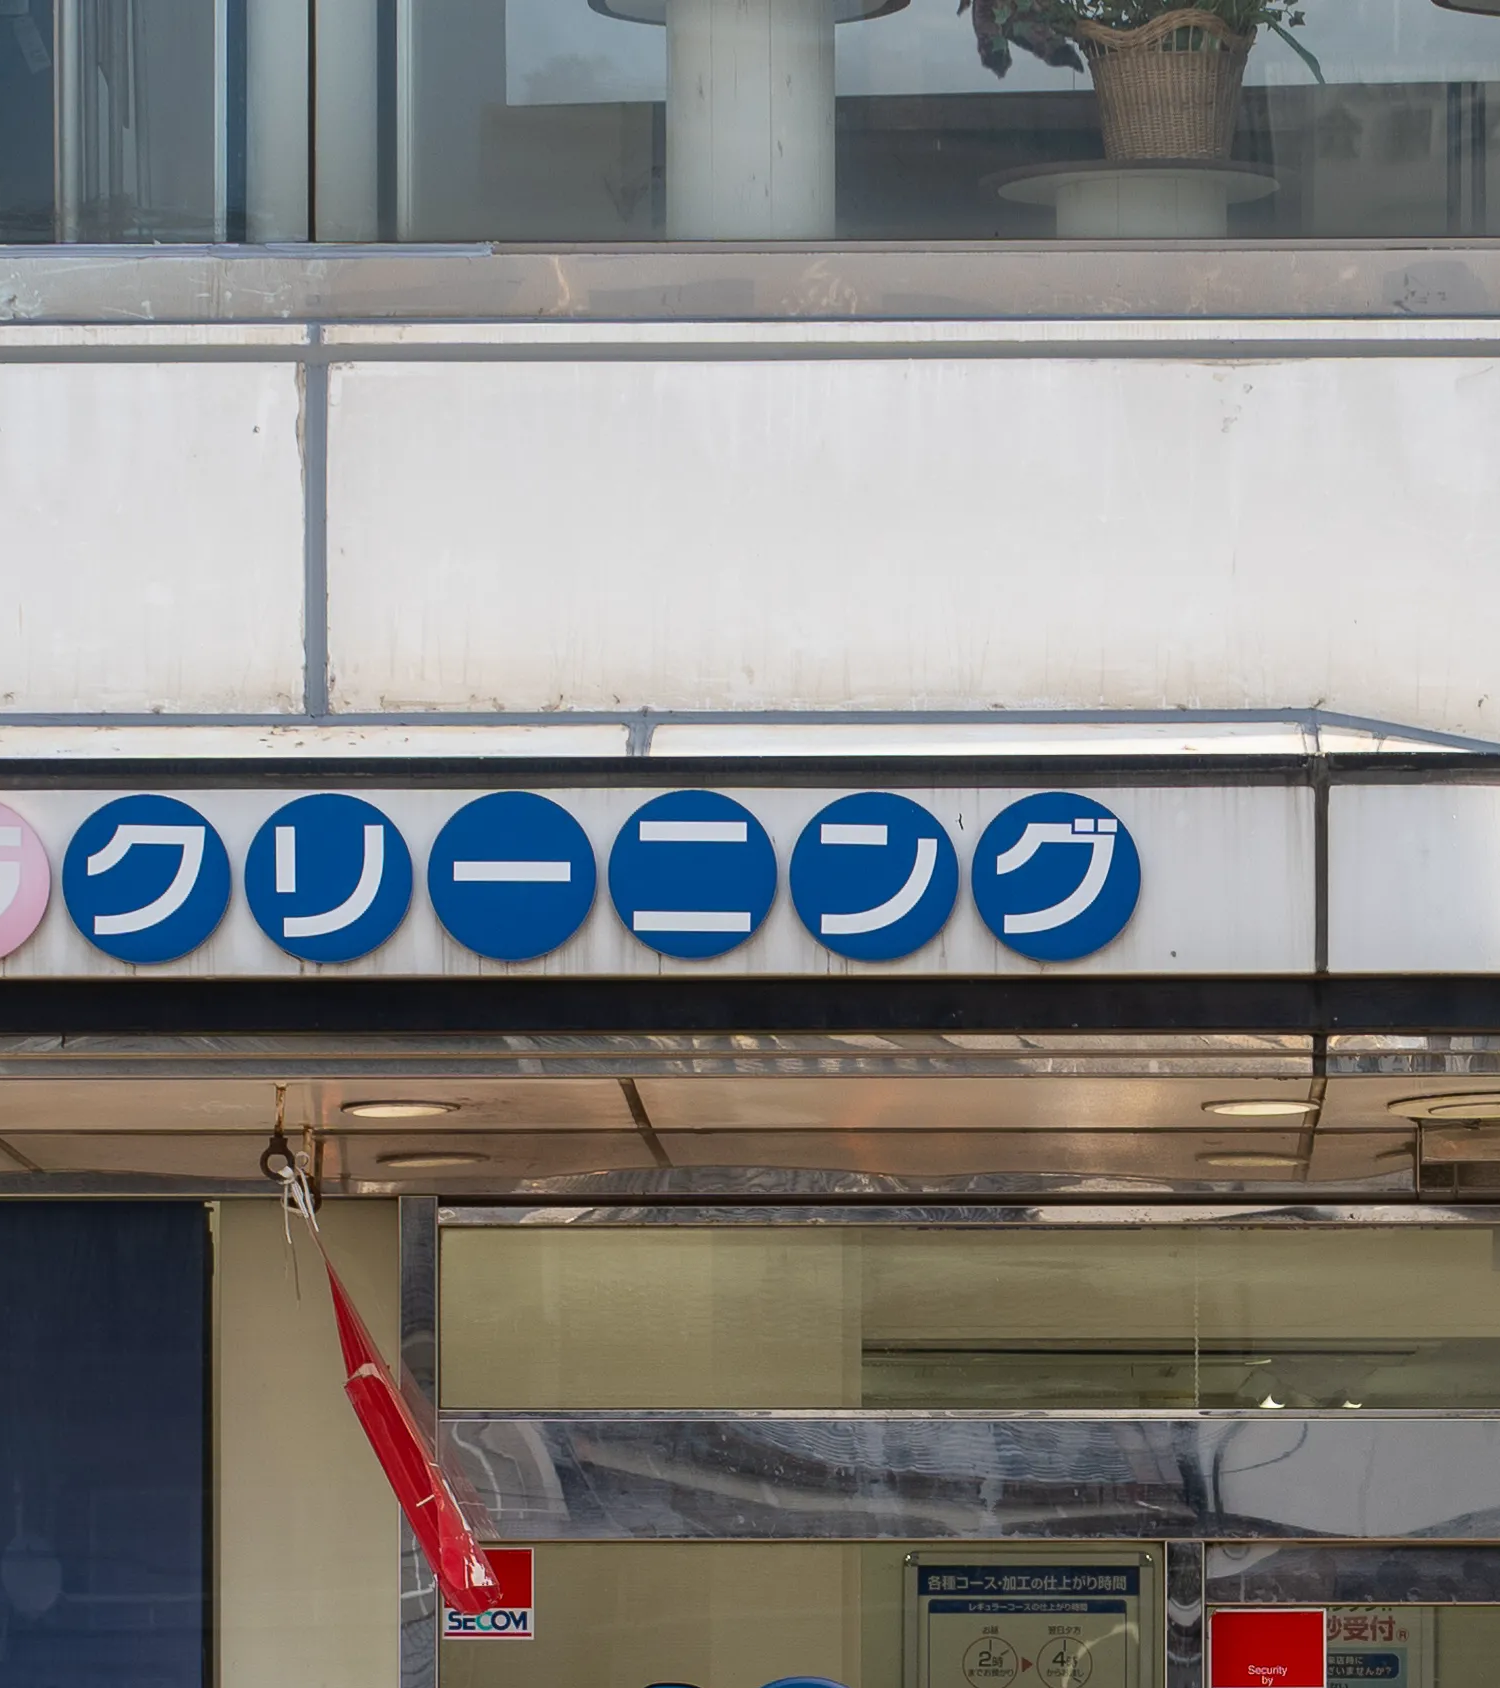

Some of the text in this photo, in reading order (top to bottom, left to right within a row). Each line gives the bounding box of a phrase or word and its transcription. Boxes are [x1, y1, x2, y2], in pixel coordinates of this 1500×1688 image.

[448, 1610, 527, 1630] SECOM
[1248, 1664, 1288, 1677] Security
[1261, 1676, 1274, 1687] by
